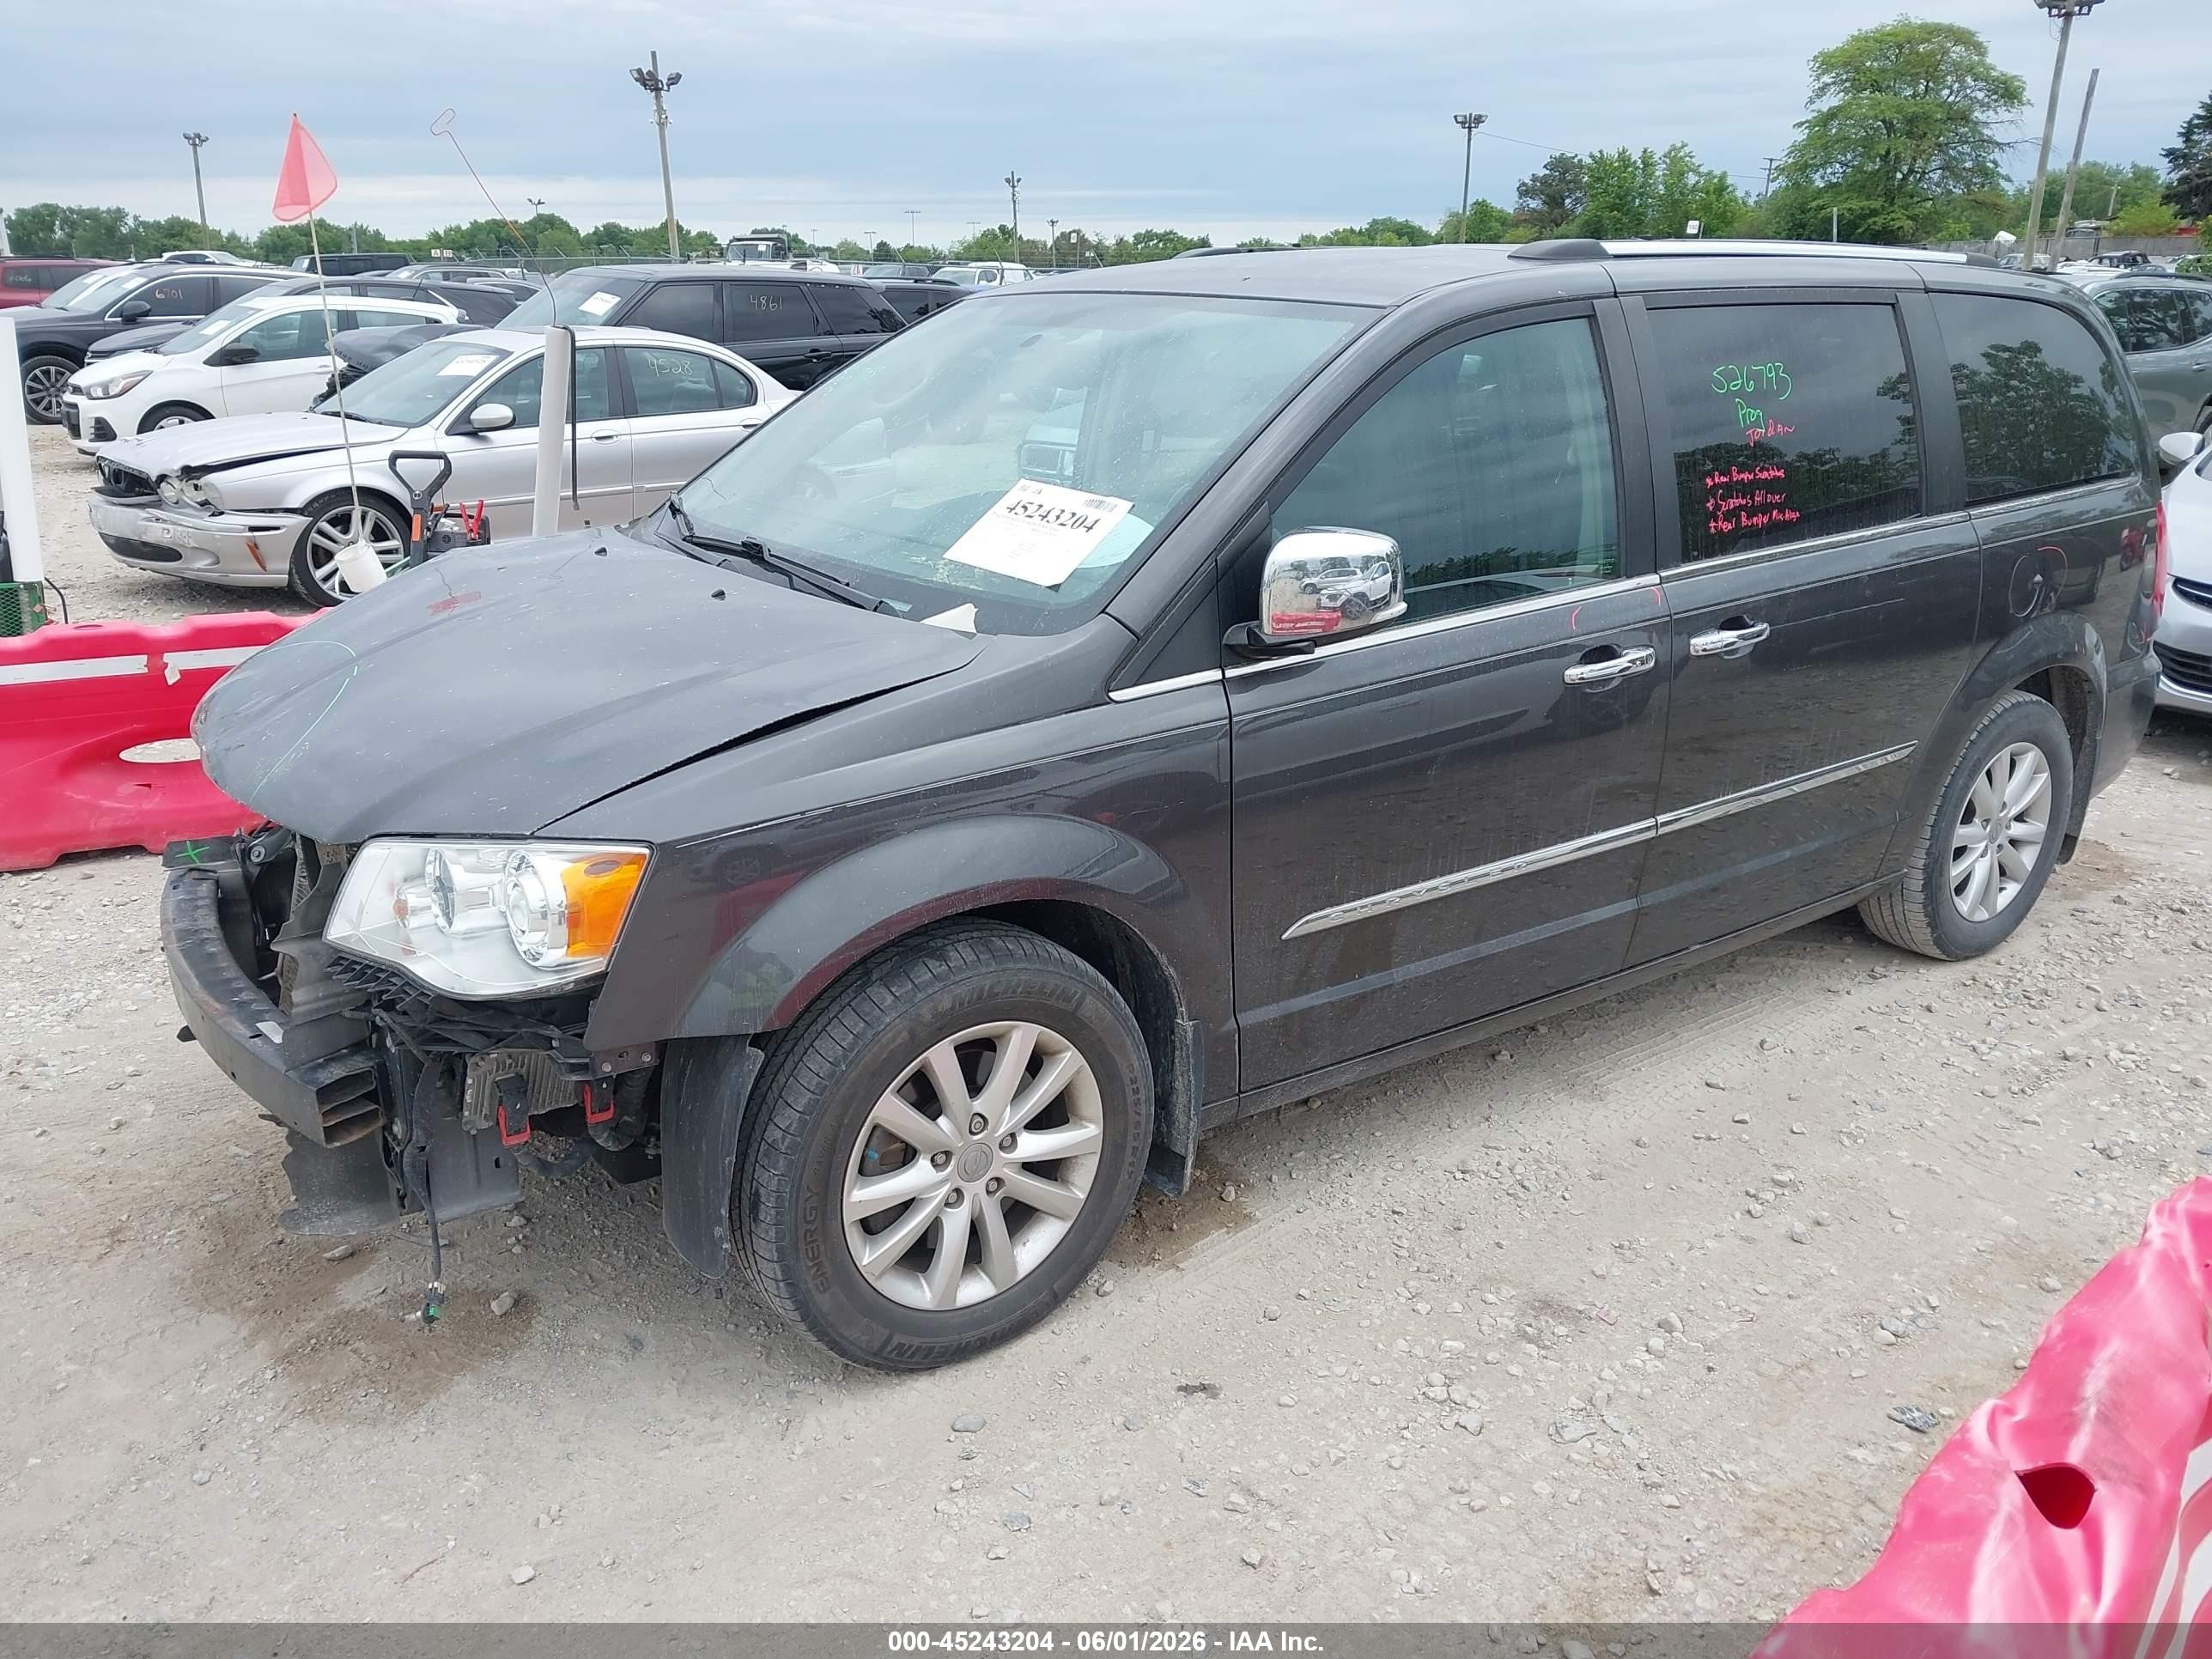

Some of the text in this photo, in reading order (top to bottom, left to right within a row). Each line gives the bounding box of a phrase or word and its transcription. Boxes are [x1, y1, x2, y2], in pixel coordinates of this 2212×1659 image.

[750, 295, 782, 311] 4861
[647, 357, 693, 377] 4528
[1711, 362, 1793, 401] 526793
[1006, 498, 1101, 534] 45243204
[802, 1183, 831, 1295] ENERGY
